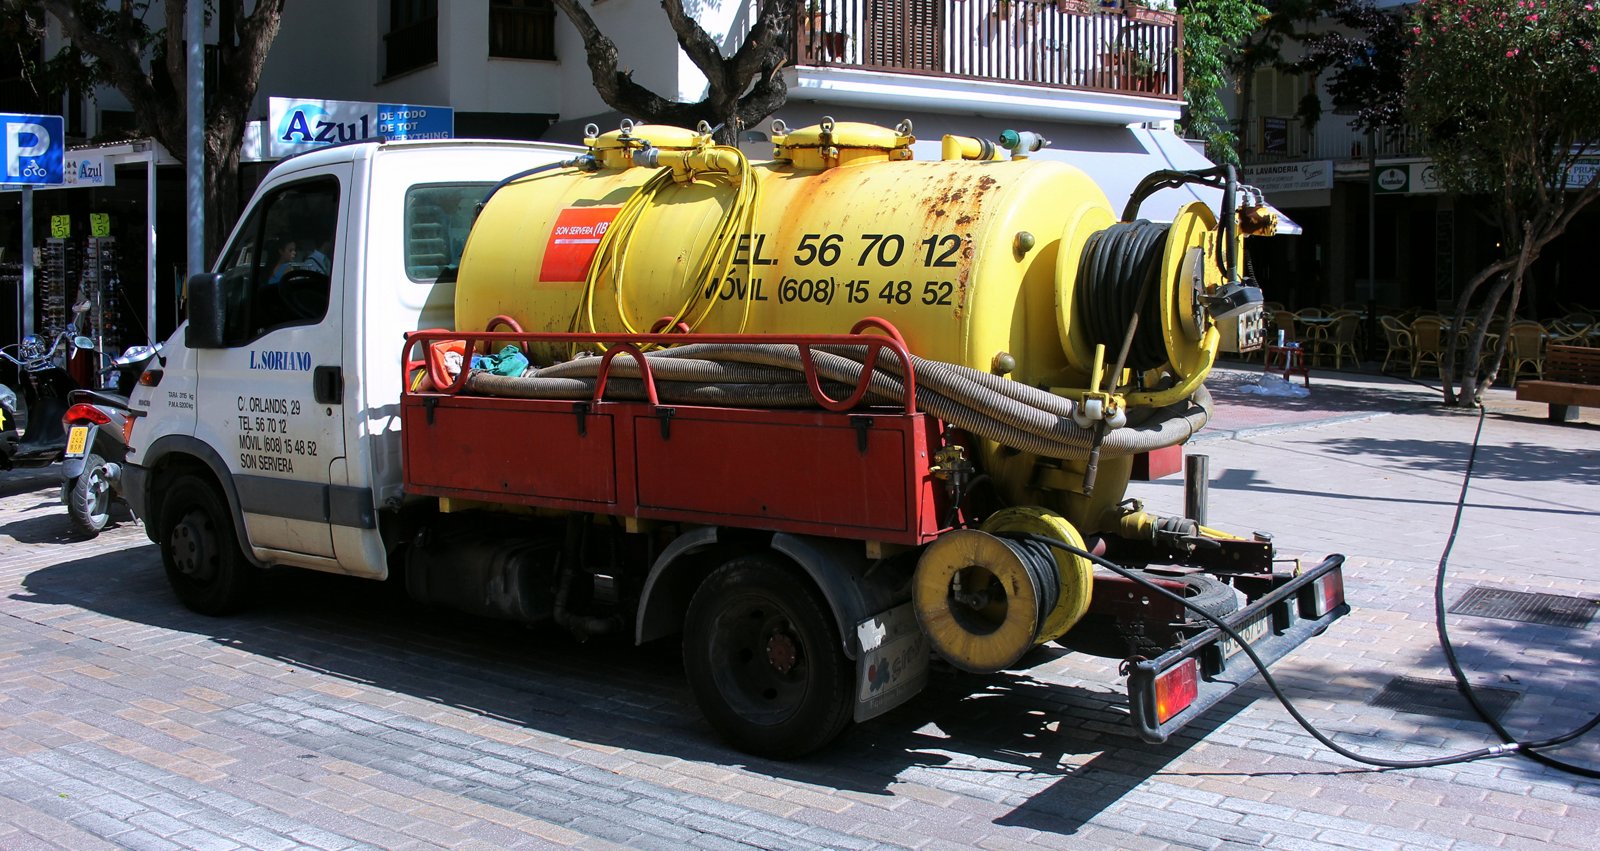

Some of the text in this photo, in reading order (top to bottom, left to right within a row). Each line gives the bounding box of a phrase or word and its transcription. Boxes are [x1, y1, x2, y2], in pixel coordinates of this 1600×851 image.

[380, 109, 427, 121] DE TODO
[282, 110, 369, 143] Azul
[380, 121, 418, 133] DE TOT
[6, 122, 51, 177] P
[79, 161, 102, 178] Azul
[1255, 164, 1298, 175] LAVANDERIA
[555, 226, 568, 235] SON
[569, 226, 593, 235] SERVERA
[718, 234, 961, 267] EL. 56 70 12
[778, 276, 835, 305] (608)
[845, 280, 869, 304] 15
[879, 280, 912, 305] 48
[921, 281, 953, 305] 52
[249, 350, 312, 371] L.SORIANO
[249, 396, 289, 416] ORLANDIS,
[291, 400, 301, 415] 29
[256, 417, 265, 432] 56
[267, 418, 276, 433] 70
[279, 419, 287, 433] 12
[239, 431, 317, 456] MÓVIL (608) 15 48 52
[241, 453, 294, 473] SON SERVERA
